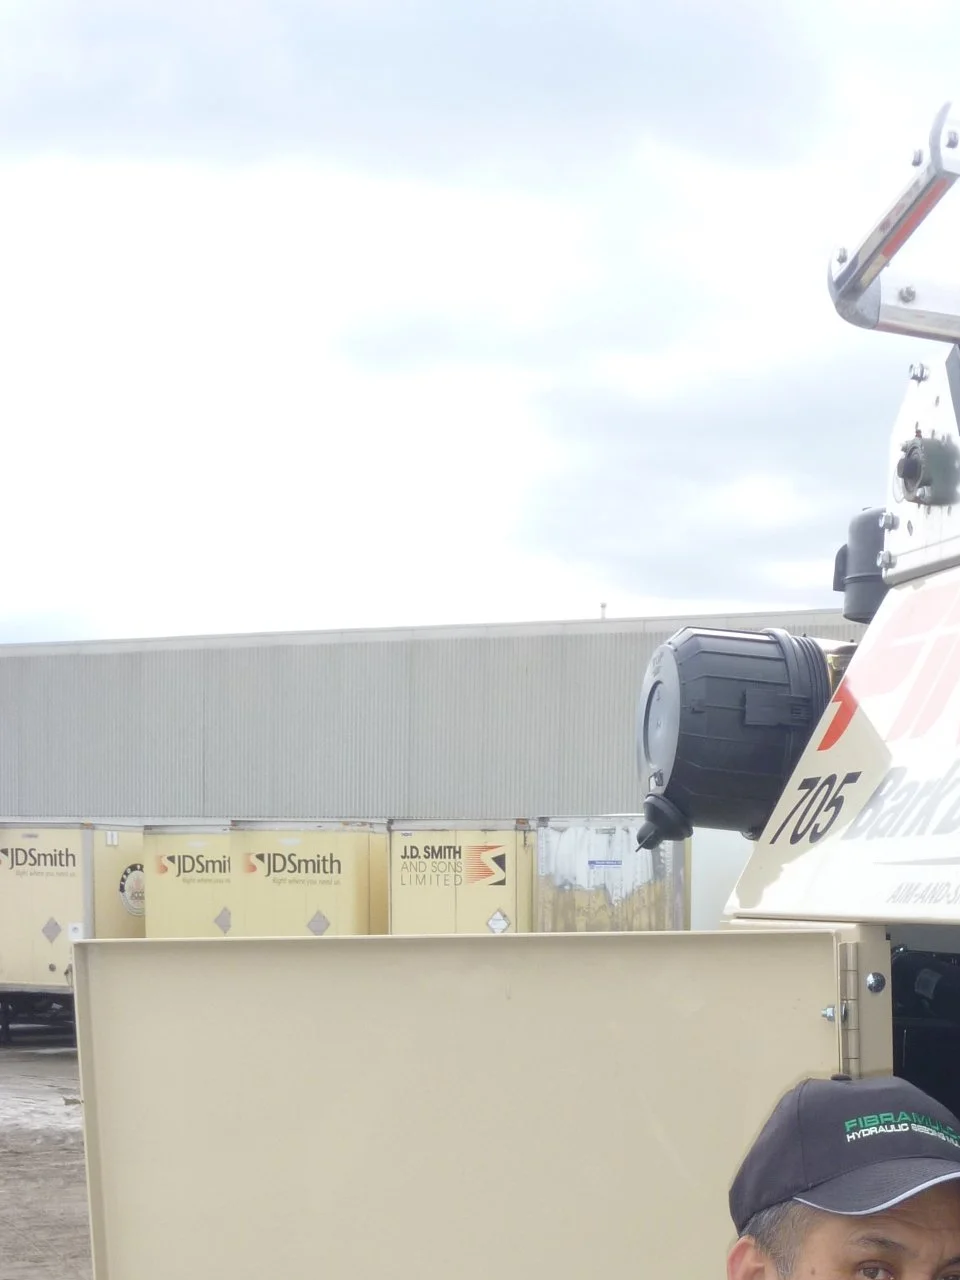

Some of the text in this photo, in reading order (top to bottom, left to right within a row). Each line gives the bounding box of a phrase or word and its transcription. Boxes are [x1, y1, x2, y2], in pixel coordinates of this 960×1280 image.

[769, 771, 864, 845] 705
[9, 848, 76, 870] JDSmith
[400, 845, 462, 859] J.D. SMITH
[265, 853, 341, 877] JDSmith
[401, 861, 463, 873] AND SONS
[400, 874, 463, 886] LIMITED
[846, 1123, 909, 1142] HYDRAULIC
